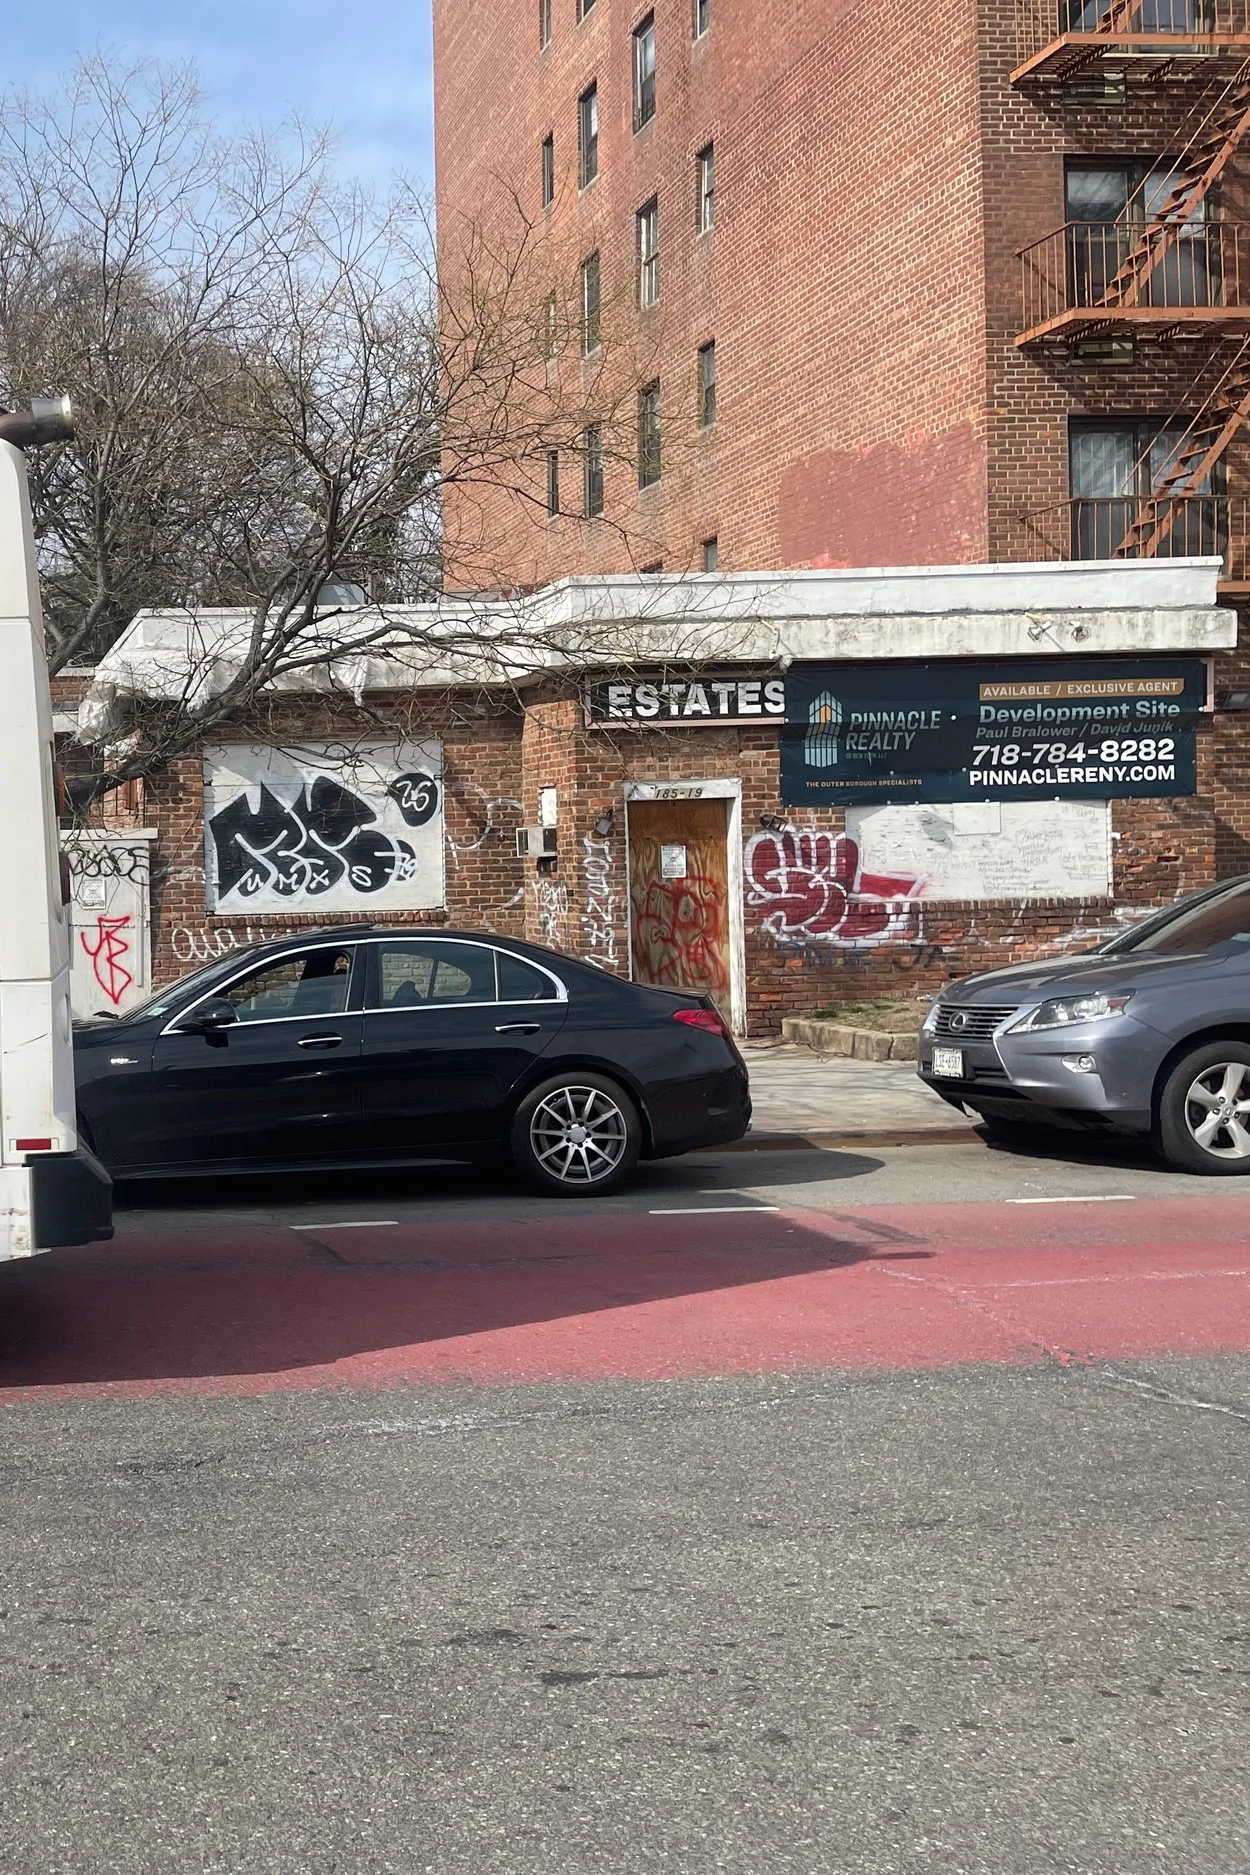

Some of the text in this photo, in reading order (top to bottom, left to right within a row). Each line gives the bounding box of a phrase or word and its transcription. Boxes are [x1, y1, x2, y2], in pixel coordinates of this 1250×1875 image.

[608, 680, 785, 718] ESTATES
[983, 685, 1051, 697] AVAILABLE
[1067, 682, 1135, 695] EXCLUSIVE
[1137, 681, 1178, 693] AGENT
[849, 710, 943, 730] PINNACLE
[979, 699, 1181, 725] Development Site
[976, 726, 1008, 739] Paul
[1011, 724, 1078, 739] Bralower
[1090, 722, 1131, 736] David
[845, 731, 916, 751] REALTY
[972, 738, 1175, 766] 718-784-8282
[878, 779, 923, 787] SPECIALISTS
[969, 764, 1175, 786] PINNACLERENY.COM
[655, 787, 704, 799] 185-19
